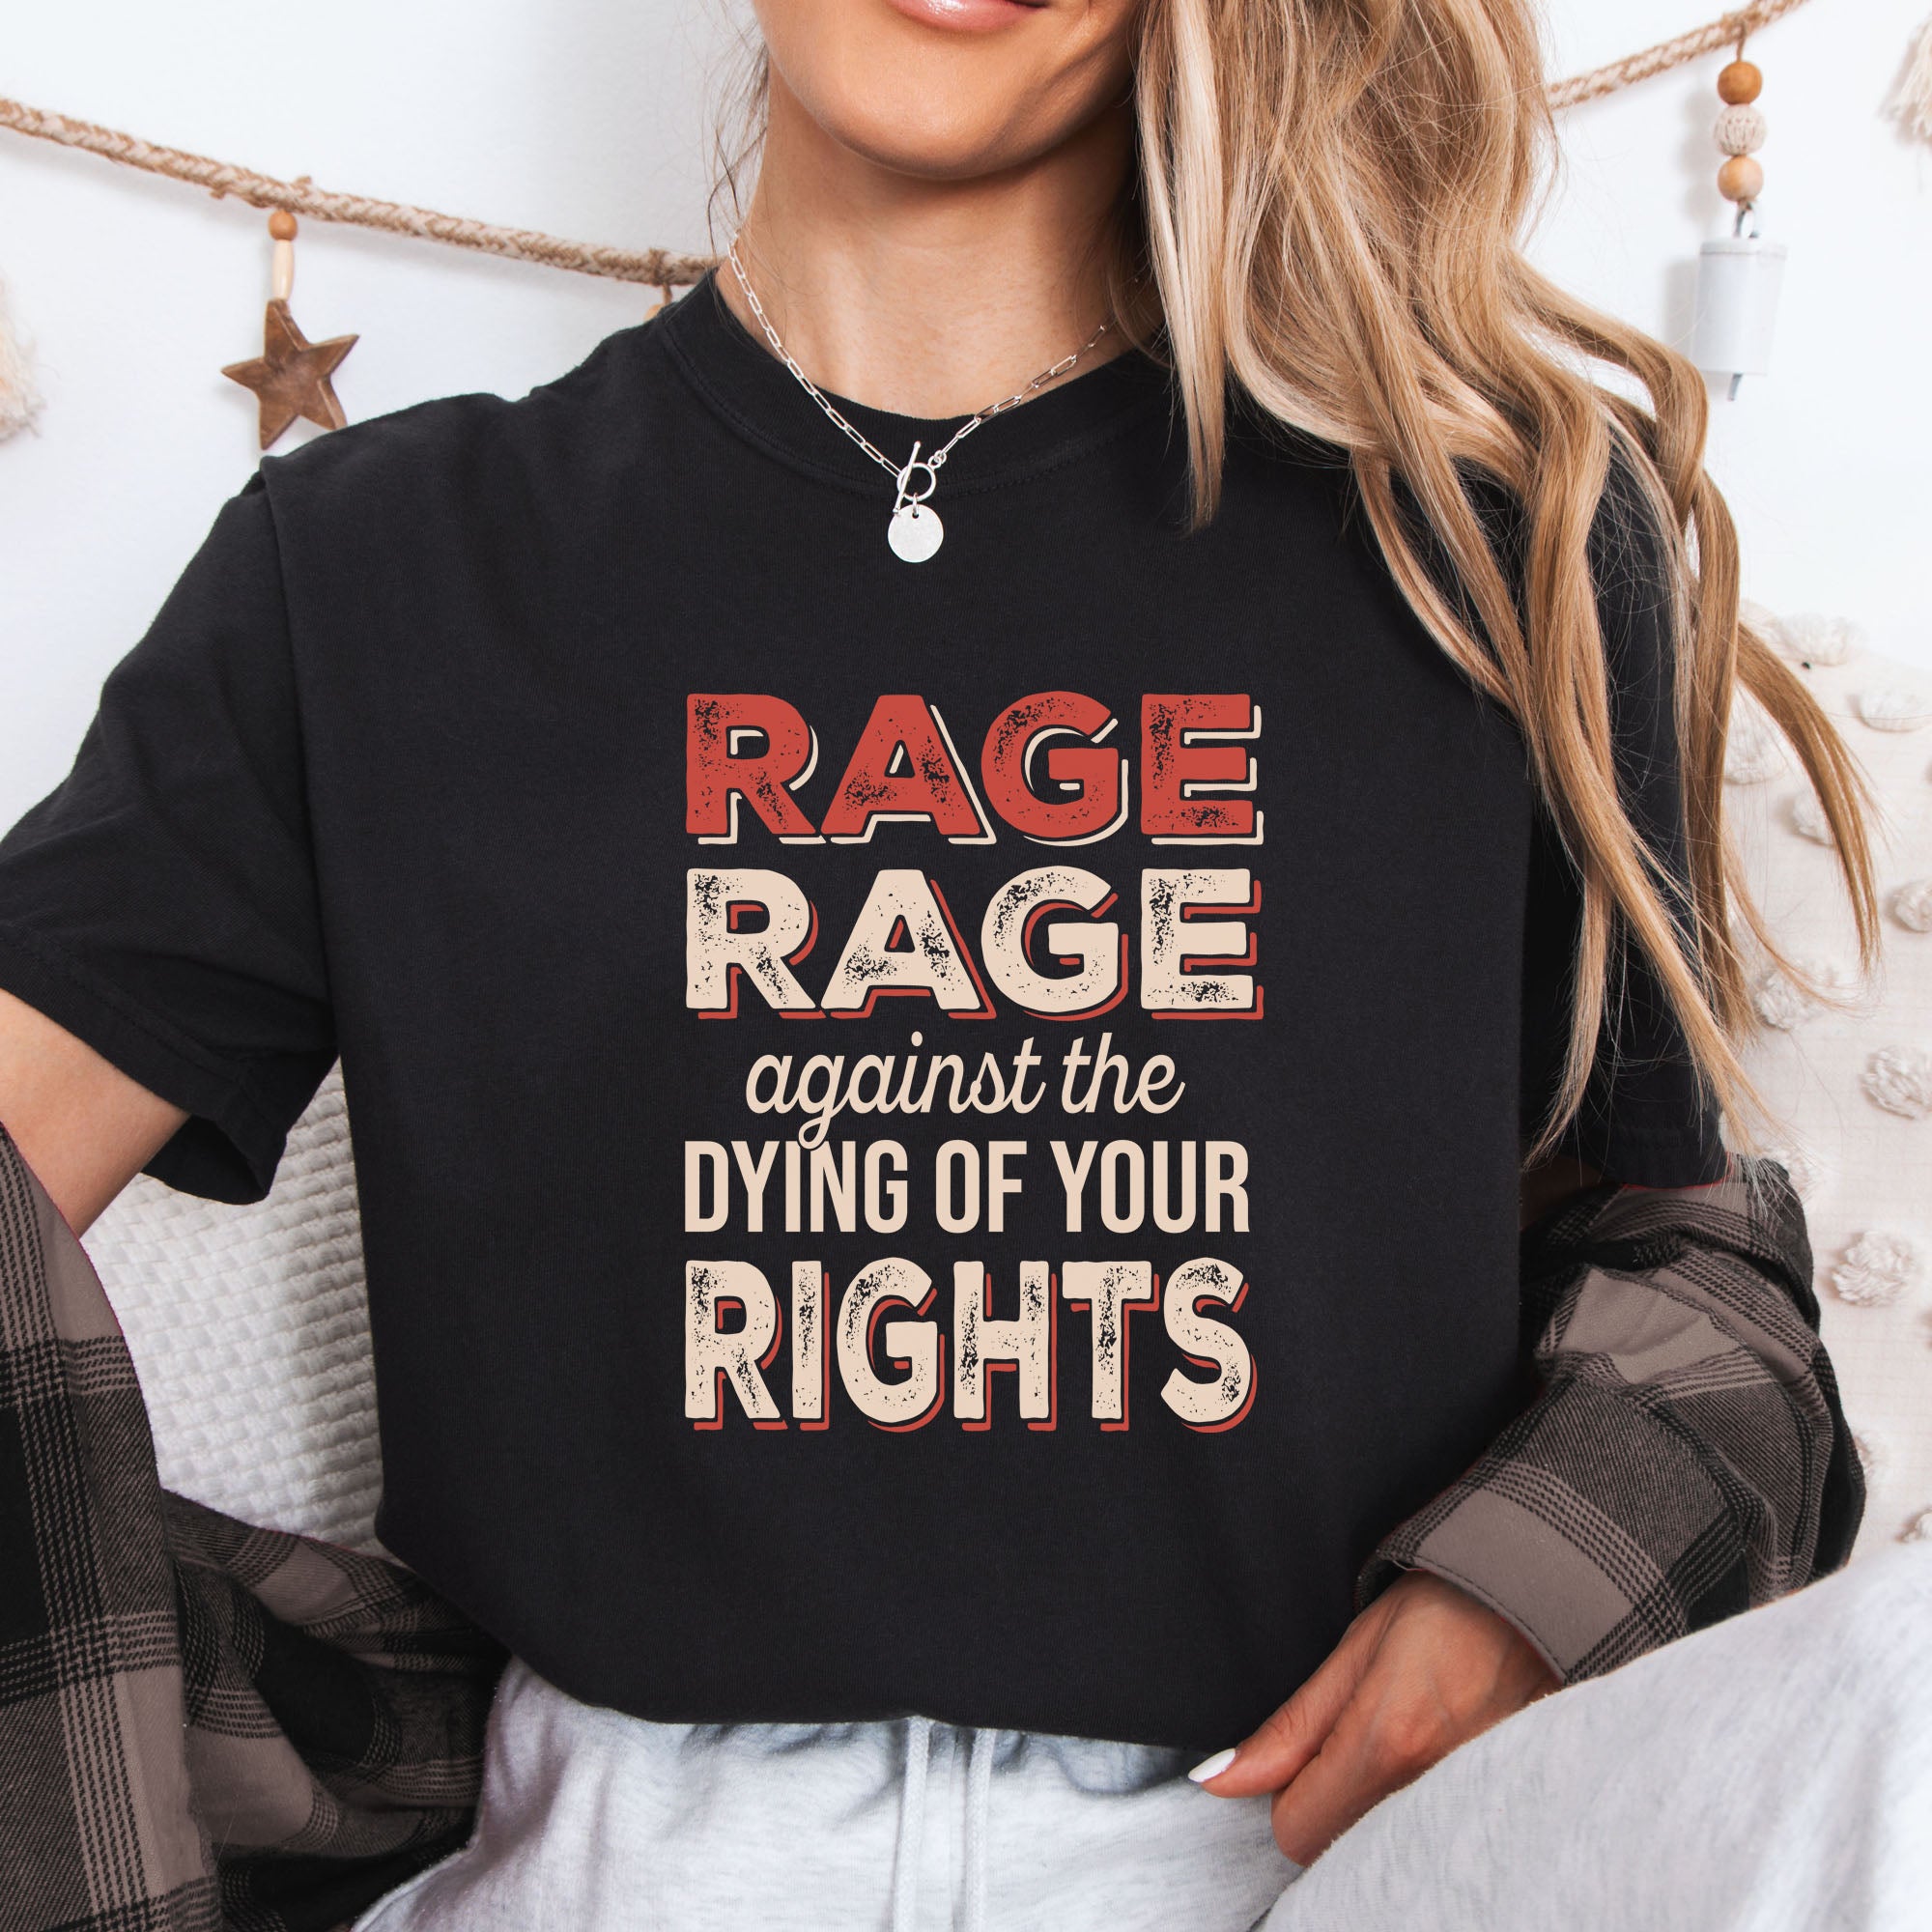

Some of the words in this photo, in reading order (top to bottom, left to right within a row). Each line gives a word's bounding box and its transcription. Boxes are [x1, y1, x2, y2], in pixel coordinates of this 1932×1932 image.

[685, 691, 1264, 847] RAGE
[685, 866, 1264, 1022] RAGE
[745, 1031, 1047, 1150] against
[1061, 1032, 1186, 1114] the
[684, 1140, 908, 1235] DYING
[935, 1140, 1028, 1235] OF
[1050, 1140, 1250, 1235] YOUR
[684, 1258, 1258, 1434] RIGHTS
